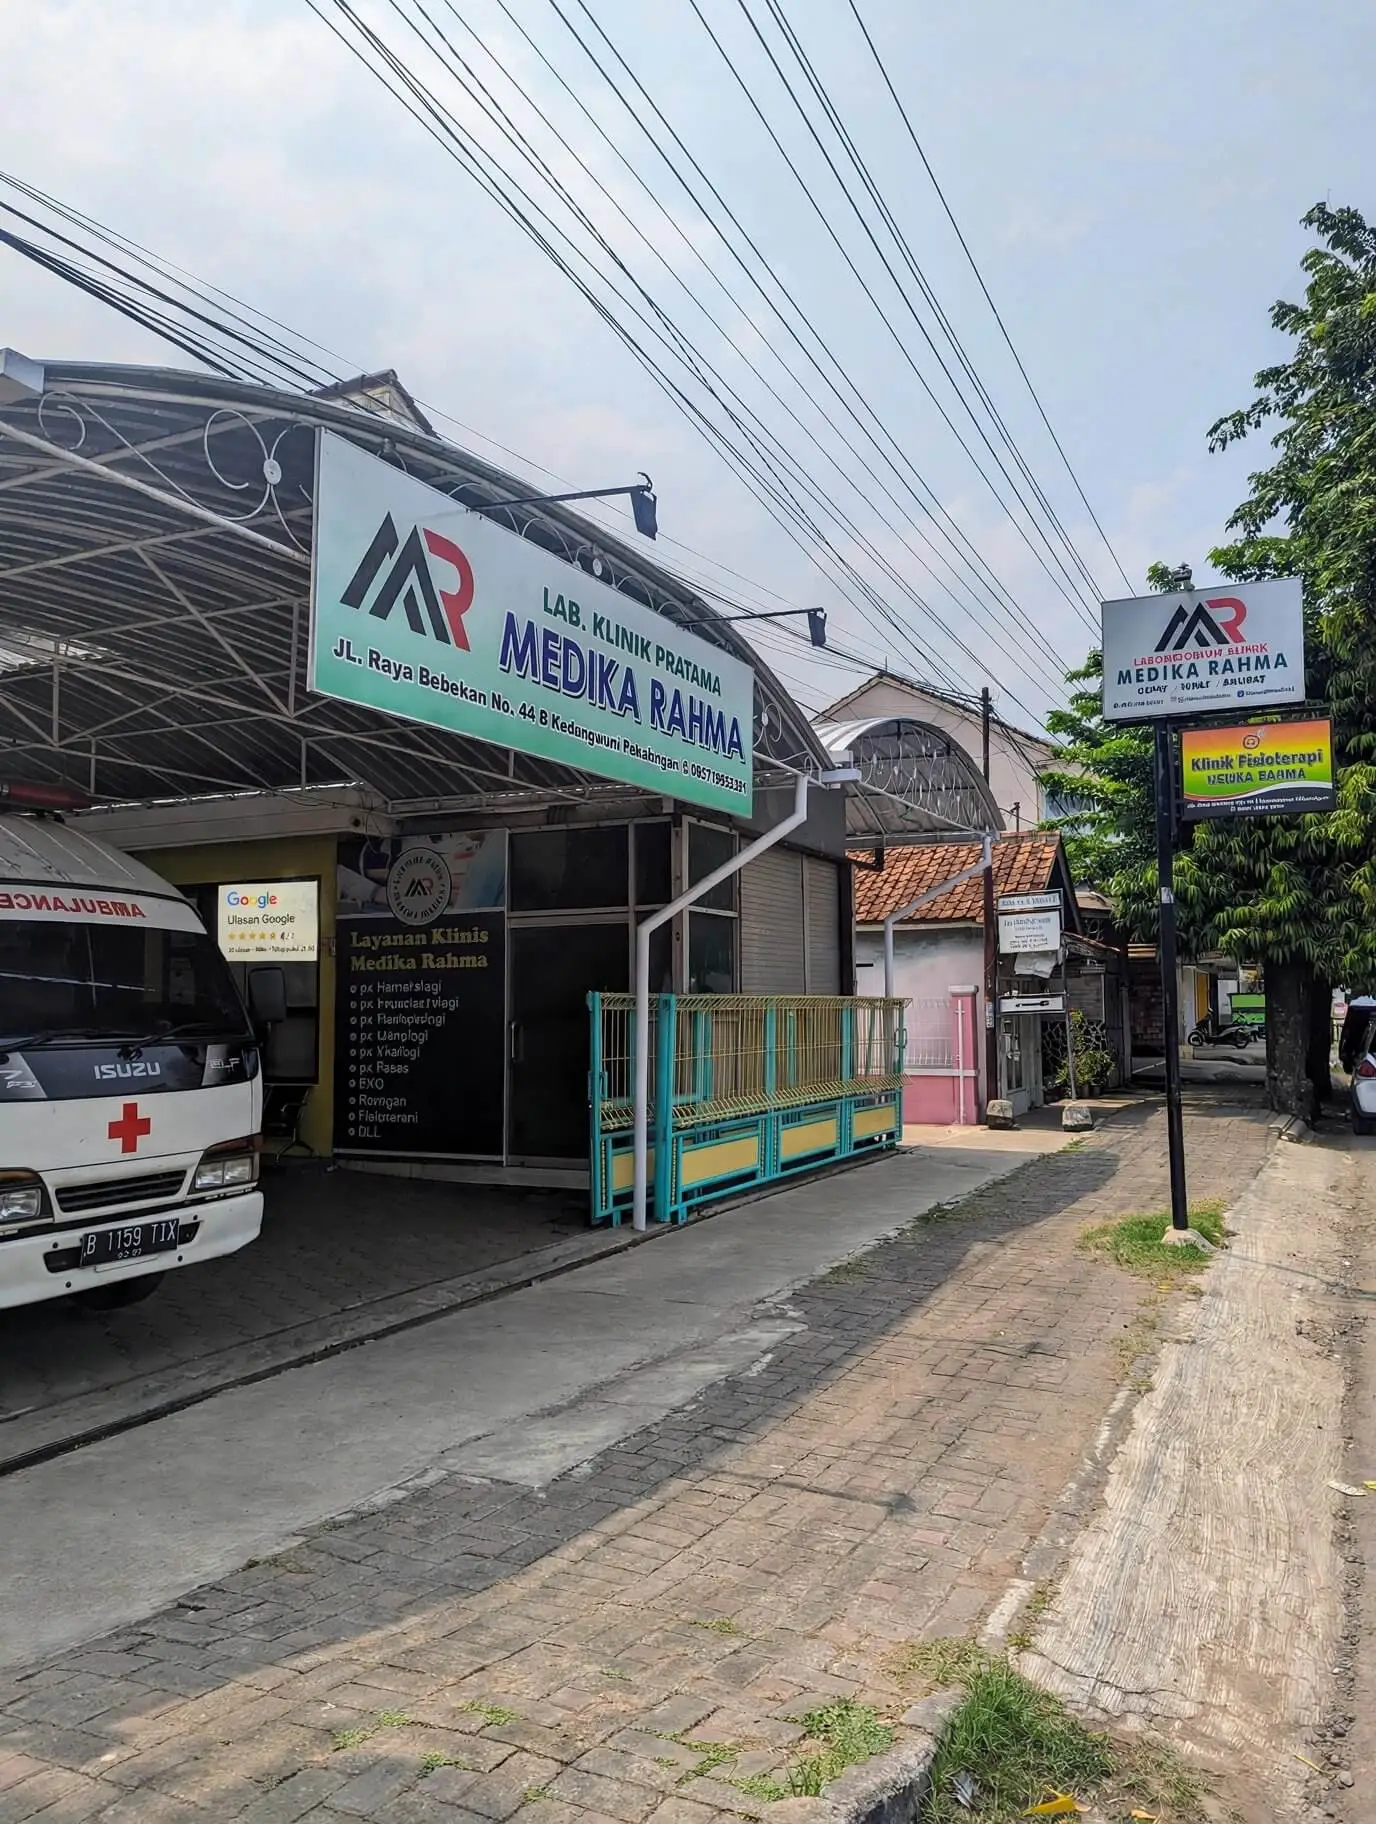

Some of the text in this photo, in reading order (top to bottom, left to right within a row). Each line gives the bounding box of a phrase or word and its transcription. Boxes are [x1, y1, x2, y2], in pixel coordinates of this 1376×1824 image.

[543, 587, 721, 696] LAB. KLINIK PRATAMA
[1117, 653, 1288, 685] MEDIKA RAHMA
[333, 638, 362, 665] JL.
[368, 649, 413, 681] Raya
[419, 667, 487, 706] Bebekan
[492, 692, 514, 716] No.
[519, 703, 535, 722] 44
[540, 712, 548, 725] B
[500, 611, 746, 763] MEDIKA RAHMA
[1191, 755, 1233, 772] Klinik
[227, 891, 277, 909] Google
[227, 913, 296, 926] Ulasan Google
[350, 931, 427, 950] Layanan
[350, 952, 488, 971] Medika Rahma
[94, 1062, 161, 1080] ISUZU
[87, 1220, 177, 1255] B 1159 TIX
